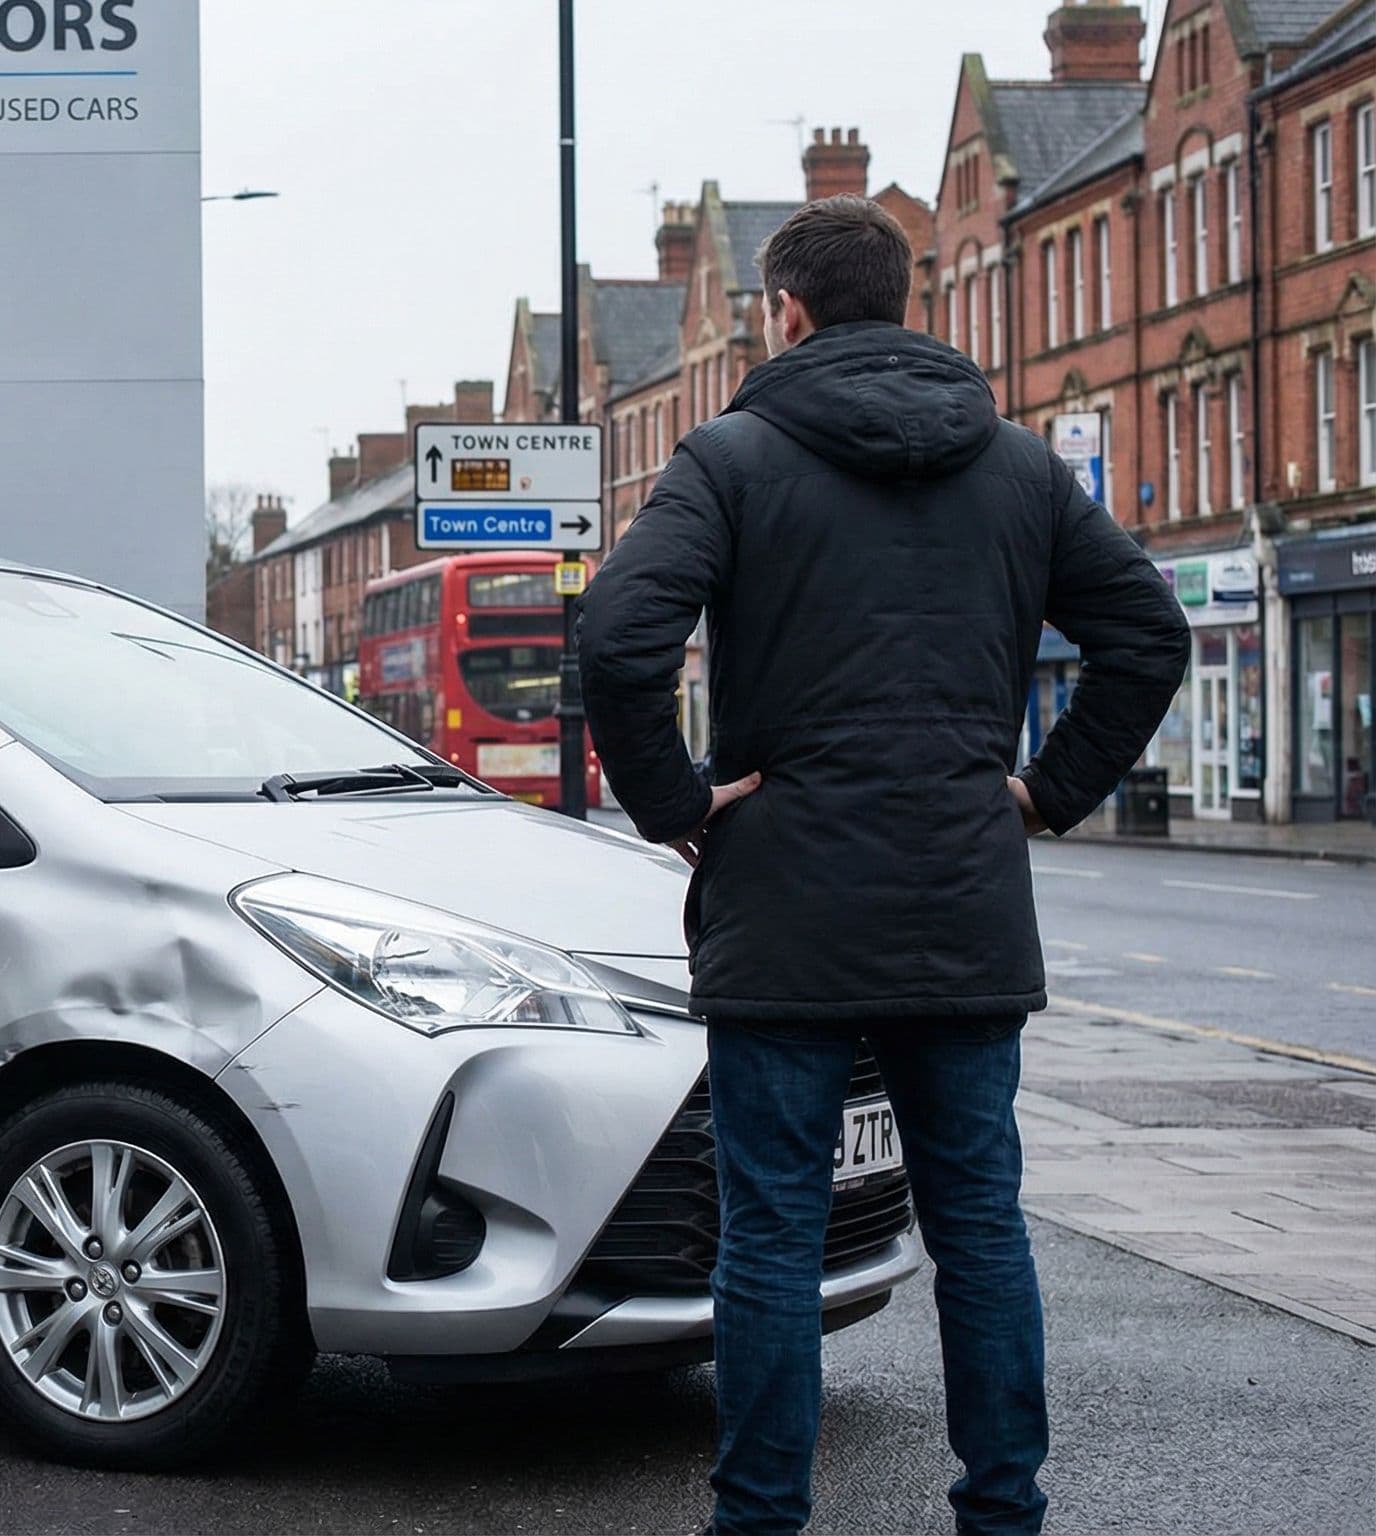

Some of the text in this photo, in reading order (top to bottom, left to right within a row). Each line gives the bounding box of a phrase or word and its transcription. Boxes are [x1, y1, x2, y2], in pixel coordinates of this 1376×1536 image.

[67, 96, 139, 121] CARS
[451, 435, 593, 450] TOWN CENTRE
[429, 516, 546, 533] Town Centre
